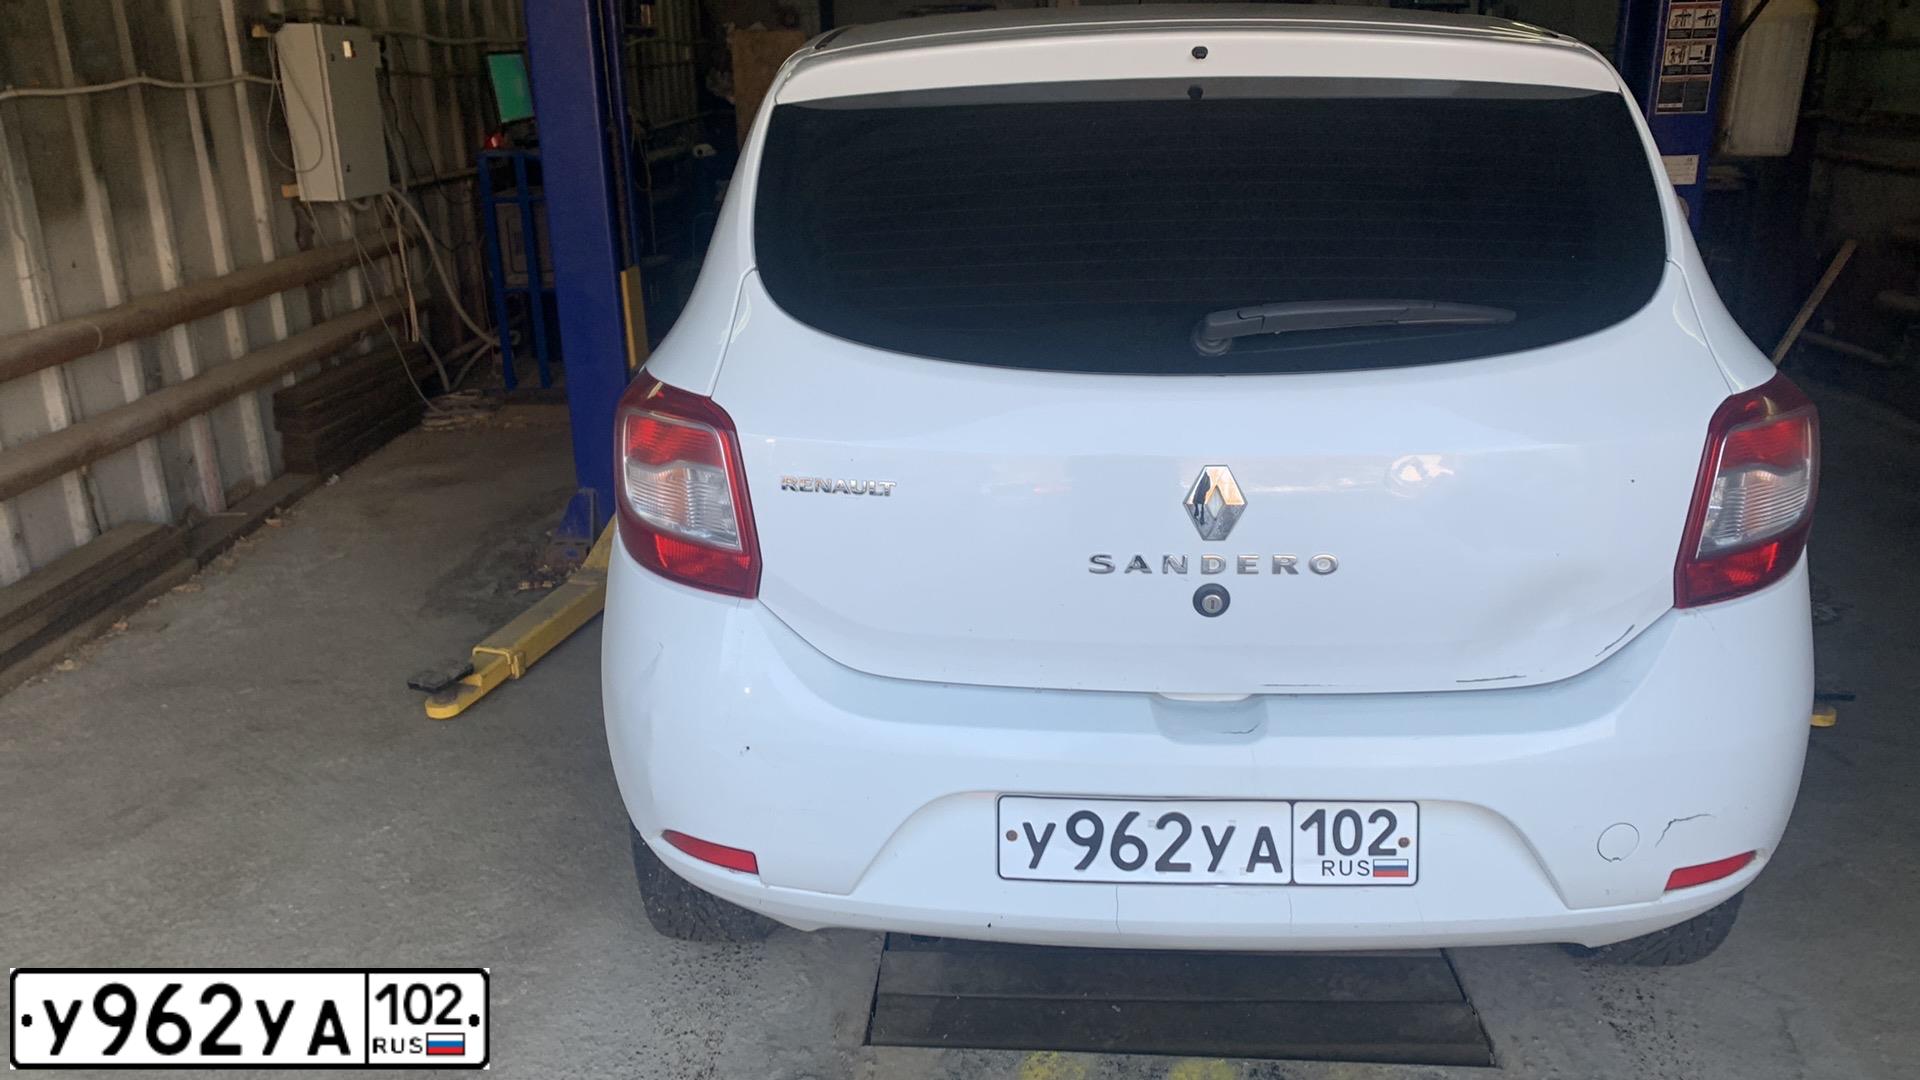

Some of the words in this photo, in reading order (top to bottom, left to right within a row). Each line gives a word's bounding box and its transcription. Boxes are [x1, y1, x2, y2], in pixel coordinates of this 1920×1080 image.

[781, 476, 897, 497] RENAULT
[1088, 553, 1339, 576] SANDERO
[1300, 808, 1398, 857] 102
[1321, 859, 1371, 877] RUS
